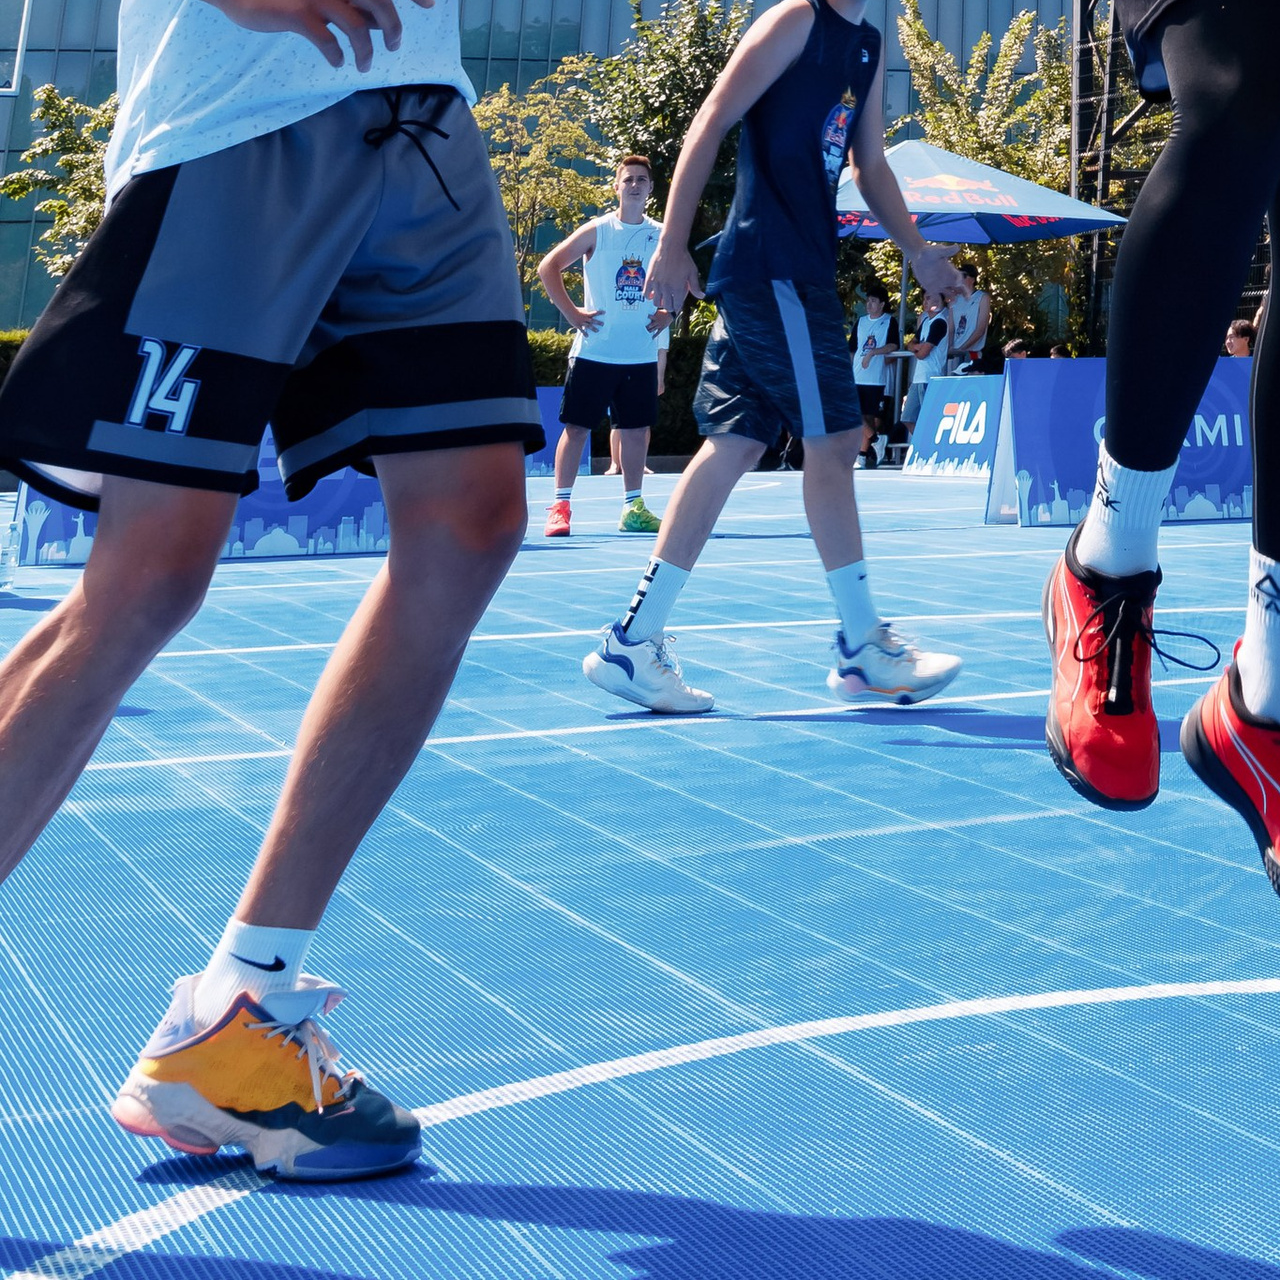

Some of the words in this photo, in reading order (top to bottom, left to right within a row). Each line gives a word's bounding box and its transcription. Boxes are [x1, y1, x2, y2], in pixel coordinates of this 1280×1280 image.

[902, 191, 962, 204] Red
[962, 192, 1019, 207] Bull
[124, 336, 202, 436] 14
[934, 400, 987, 444] FILA
